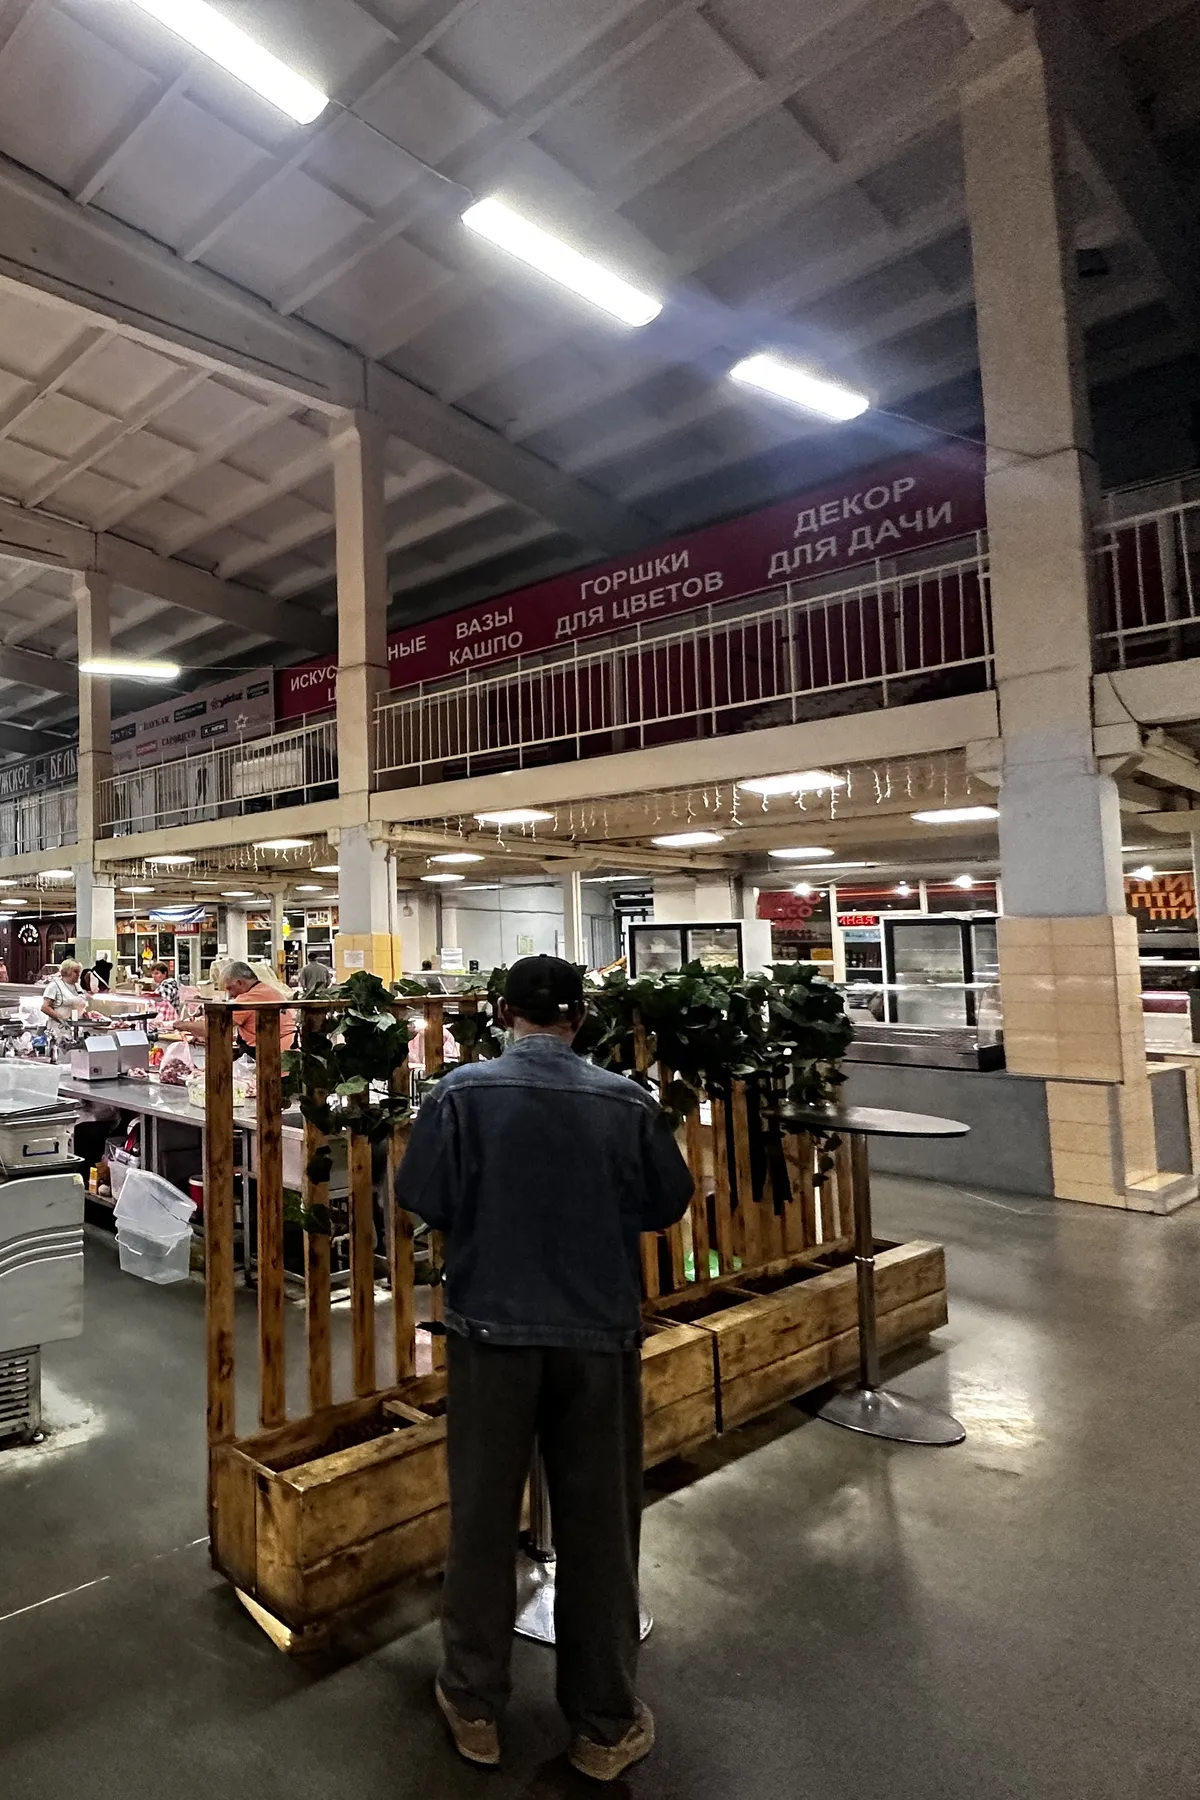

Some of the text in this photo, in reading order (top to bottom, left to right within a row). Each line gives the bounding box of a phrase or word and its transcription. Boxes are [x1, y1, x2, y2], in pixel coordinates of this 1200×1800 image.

[794, 476, 918, 538] ДЕКОР
[767, 501, 953, 579] ДЛЯ ДАЧИ
[581, 549, 690, 600] ГОРШКИ
[456, 607, 514, 640] ВАЗЫ
[556, 571, 725, 639] ДЛЯ ЦВЕТОВ
[449, 631, 524, 667] КАШПО
[50, 748, 79, 781] БЕЛЬ
